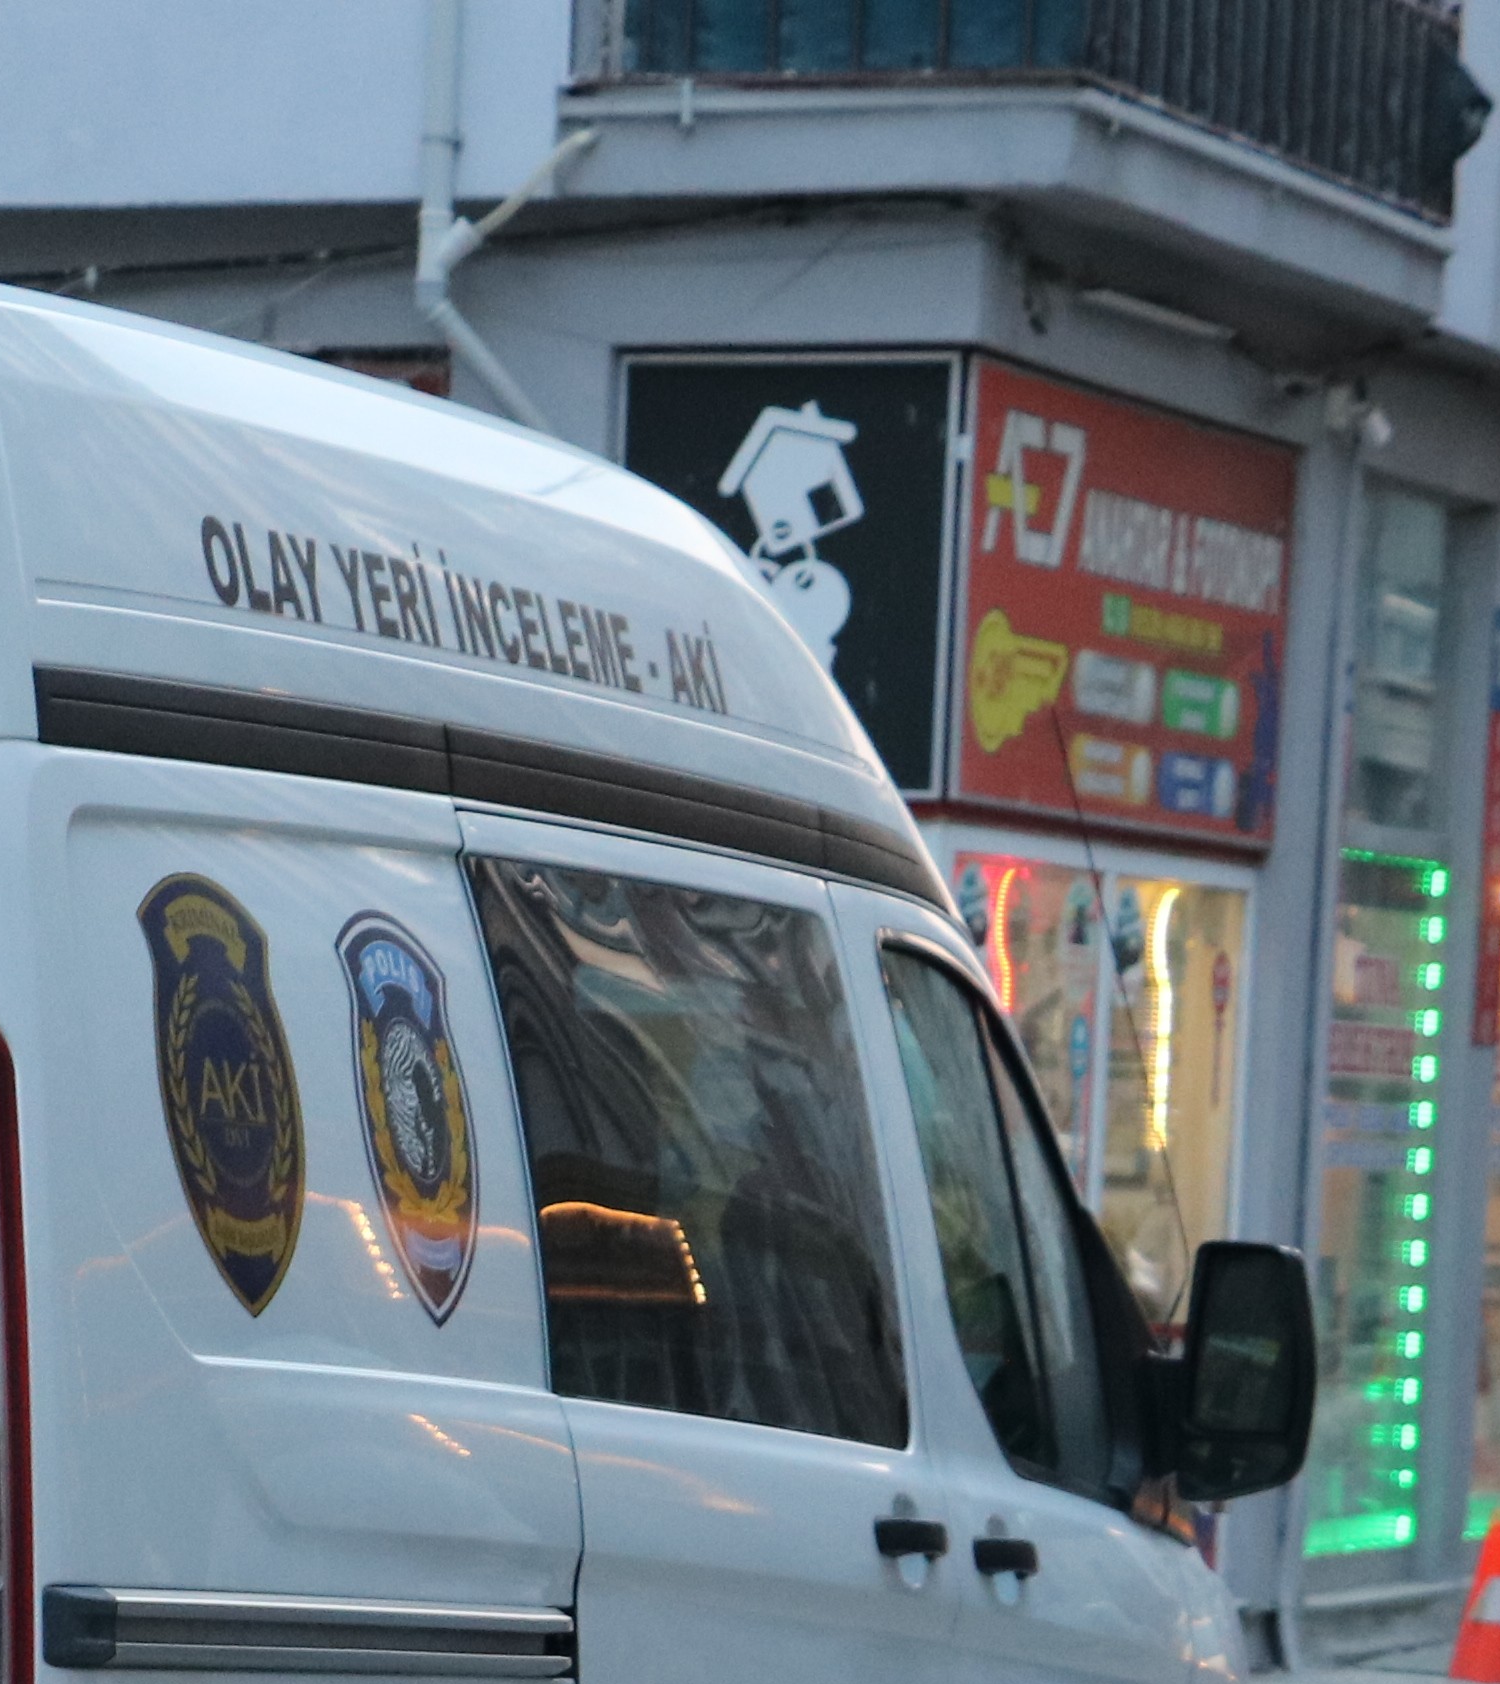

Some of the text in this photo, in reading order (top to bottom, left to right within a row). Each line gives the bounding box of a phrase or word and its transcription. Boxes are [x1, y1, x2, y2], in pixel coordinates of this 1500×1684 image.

[201, 514, 324, 625] OLAY
[329, 540, 442, 649] YERİ
[438, 548, 644, 695] İNCELEME
[664, 620, 729, 715] AKİ
